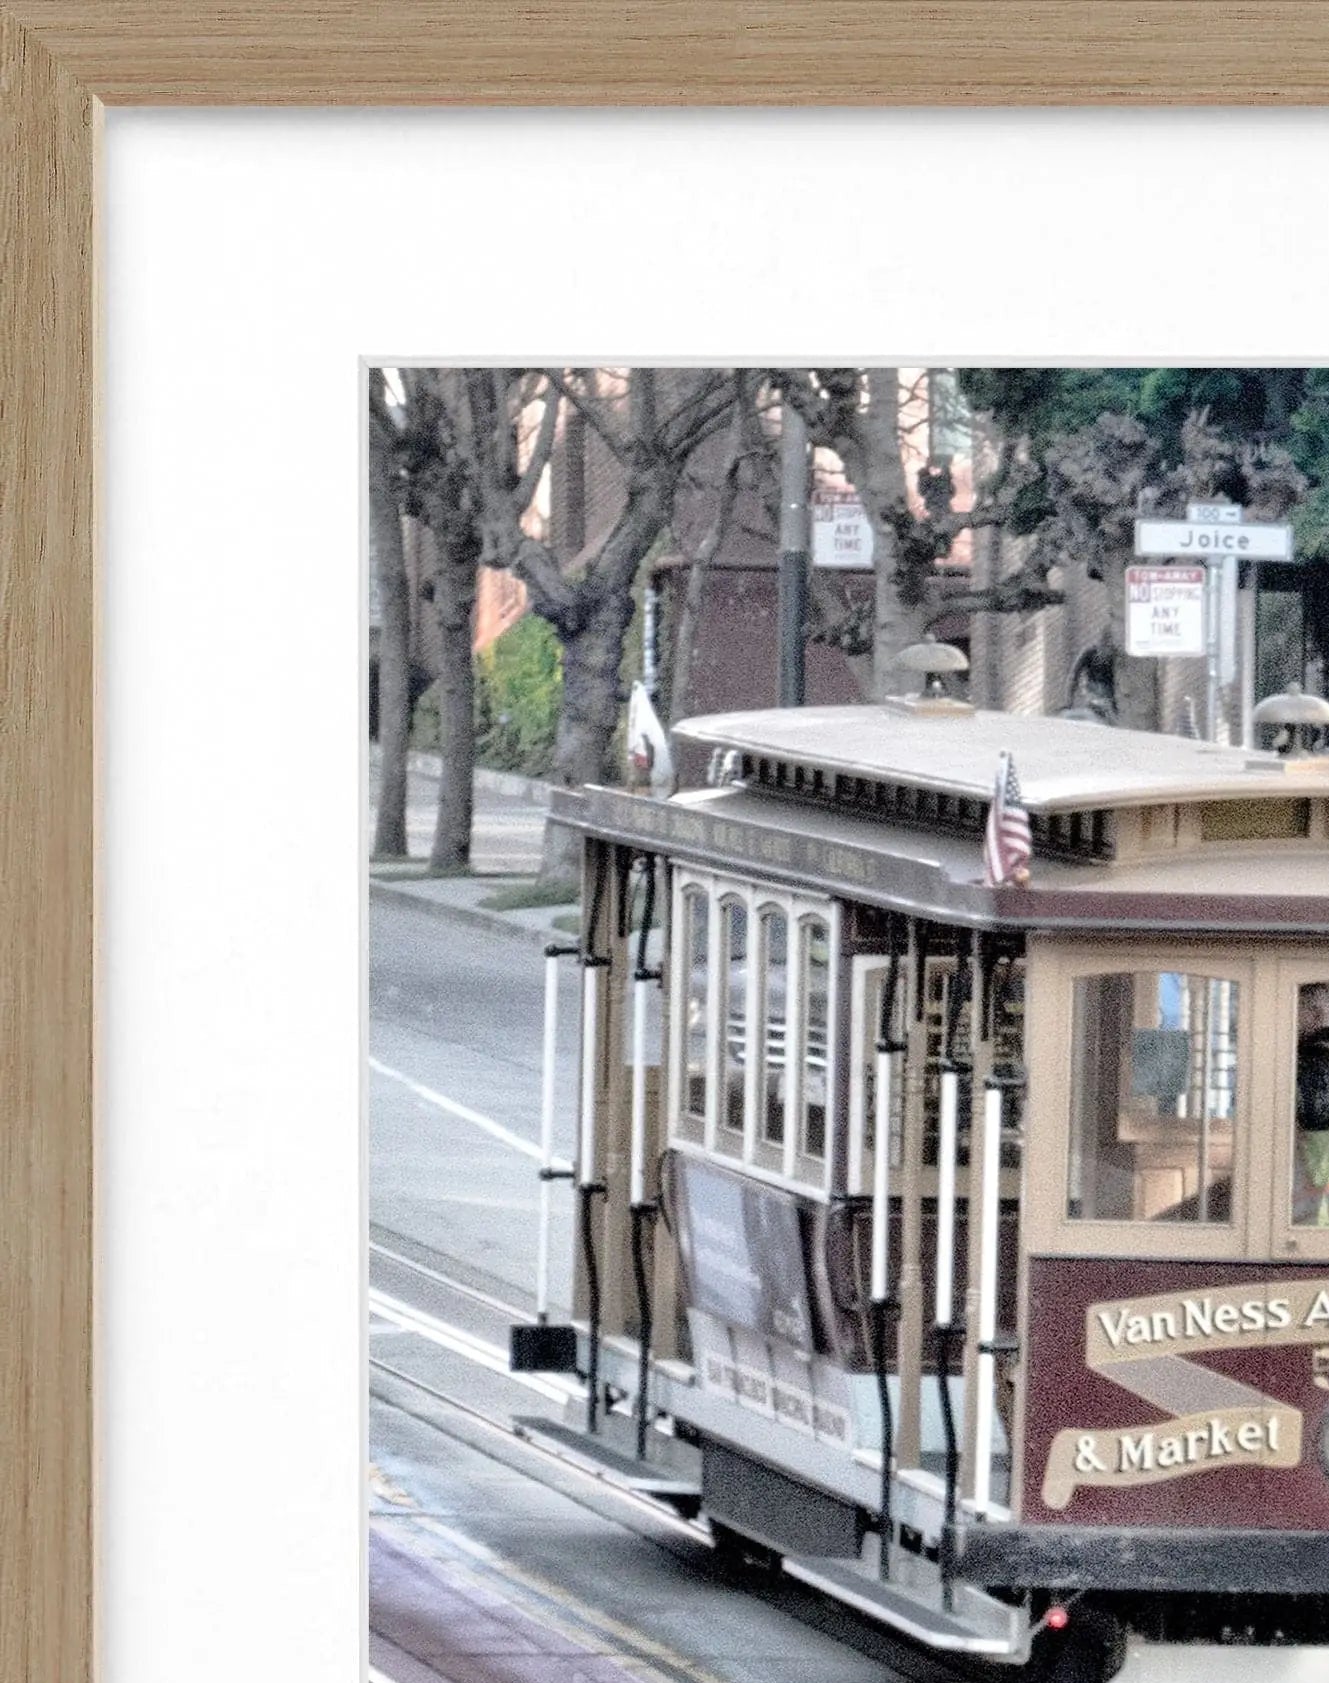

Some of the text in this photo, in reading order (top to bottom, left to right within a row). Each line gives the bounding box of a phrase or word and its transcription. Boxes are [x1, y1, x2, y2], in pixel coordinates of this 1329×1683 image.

[1180, 529, 1250, 550] Joice
[1152, 605, 1180, 619] ANY
[1151, 622, 1181, 637] TIME
[1099, 1307, 1176, 1349] Van
[1181, 1297, 1292, 1338] Ness
[1074, 1434, 1107, 1473] &
[1118, 1415, 1280, 1473] Market
